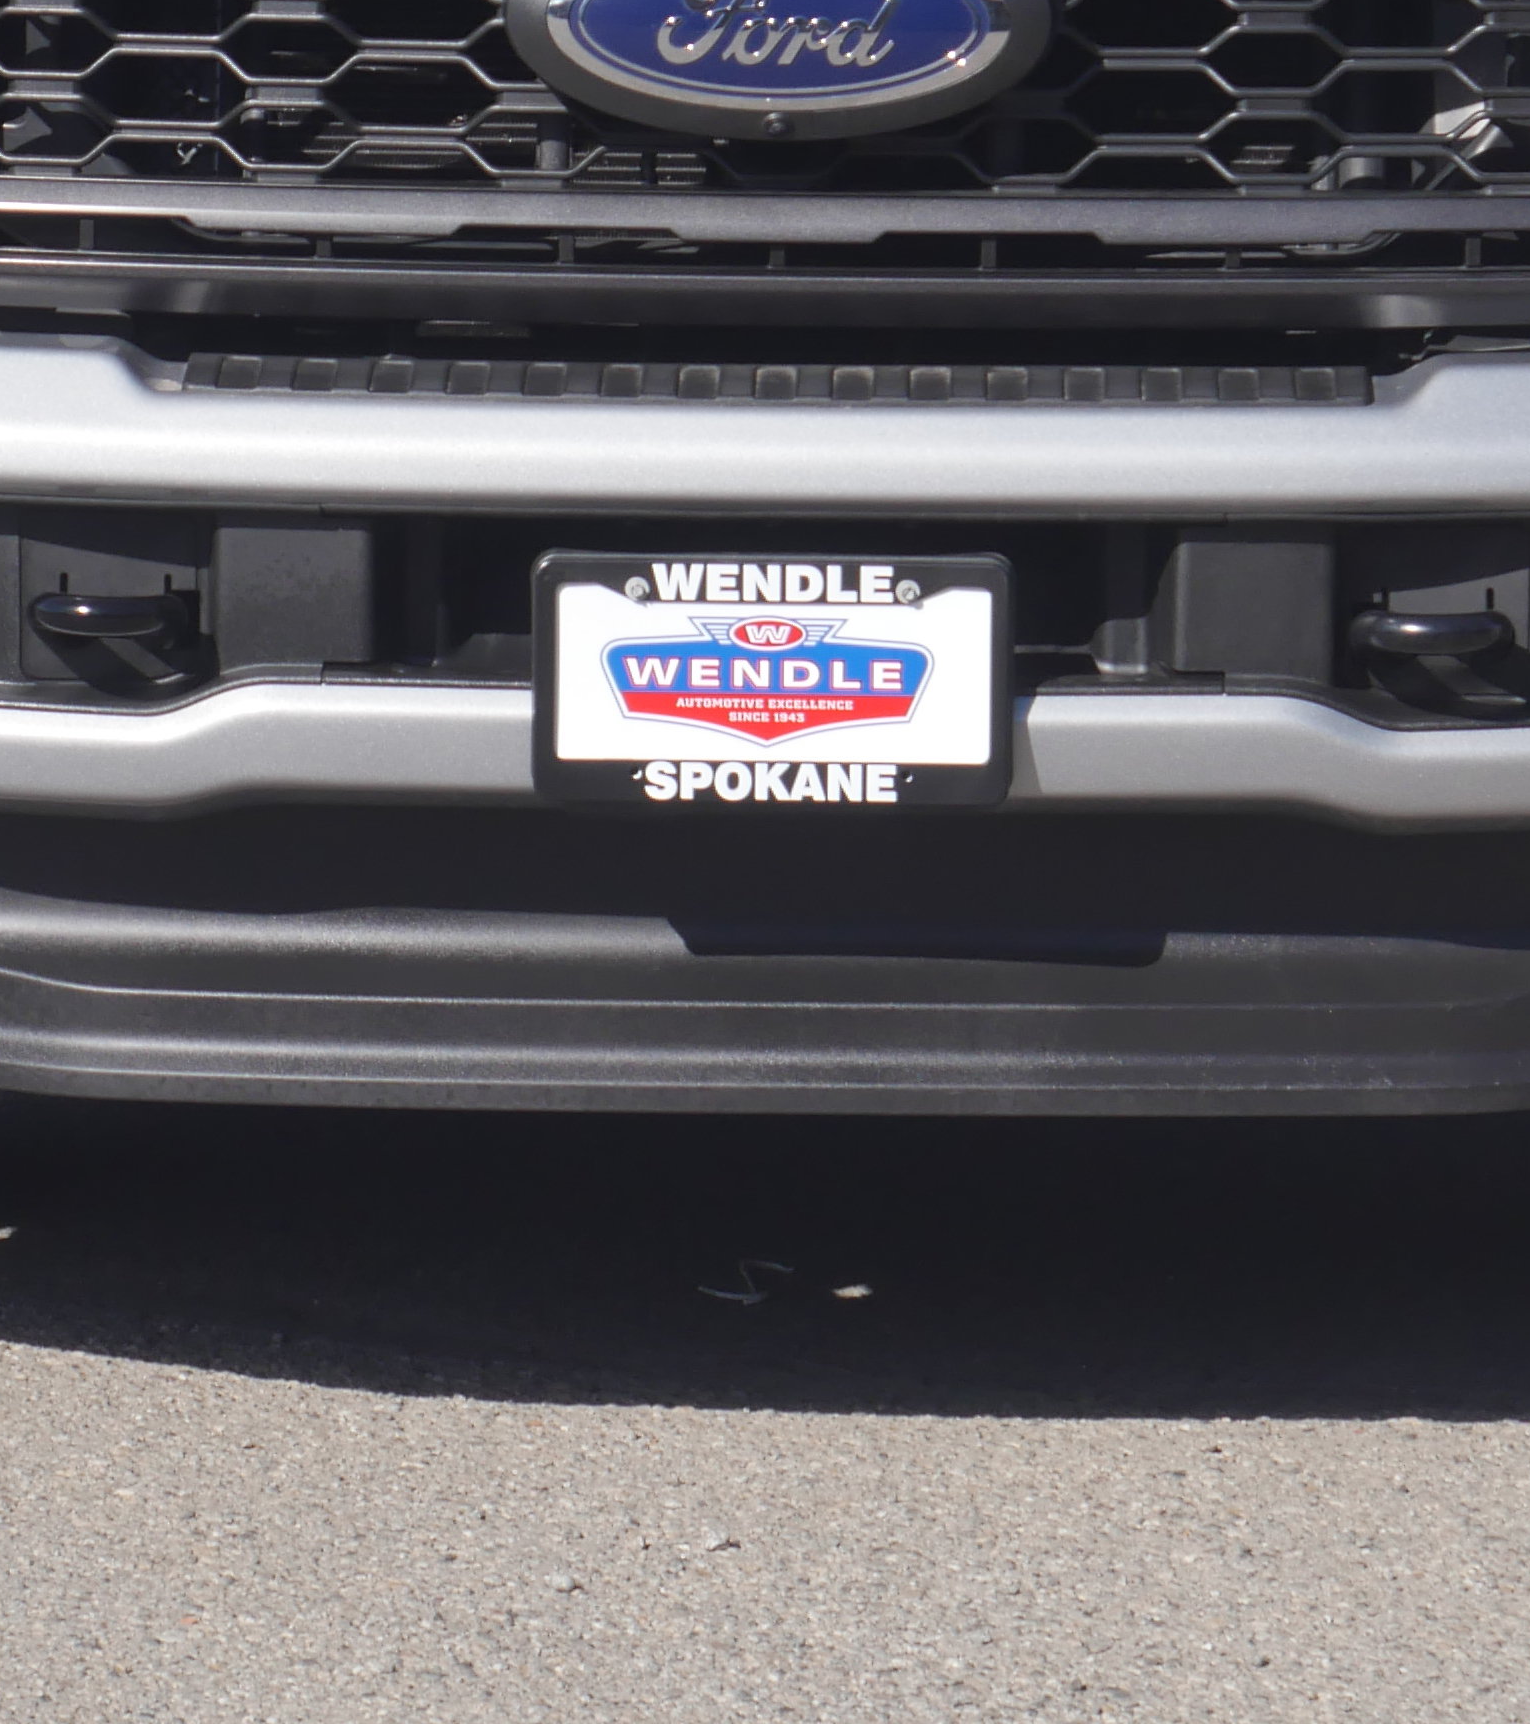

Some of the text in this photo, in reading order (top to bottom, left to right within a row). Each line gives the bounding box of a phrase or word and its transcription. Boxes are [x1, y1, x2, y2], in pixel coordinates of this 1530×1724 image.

[651, 562, 895, 604] WENDLE
[744, 623, 792, 645] W
[623, 654, 904, 692] WENDLE
[675, 696, 855, 711] AUTOMOTIVE EXCELLENCE
[728, 711, 805, 723] SINCE 1943
[644, 759, 899, 803] SPOKANE
